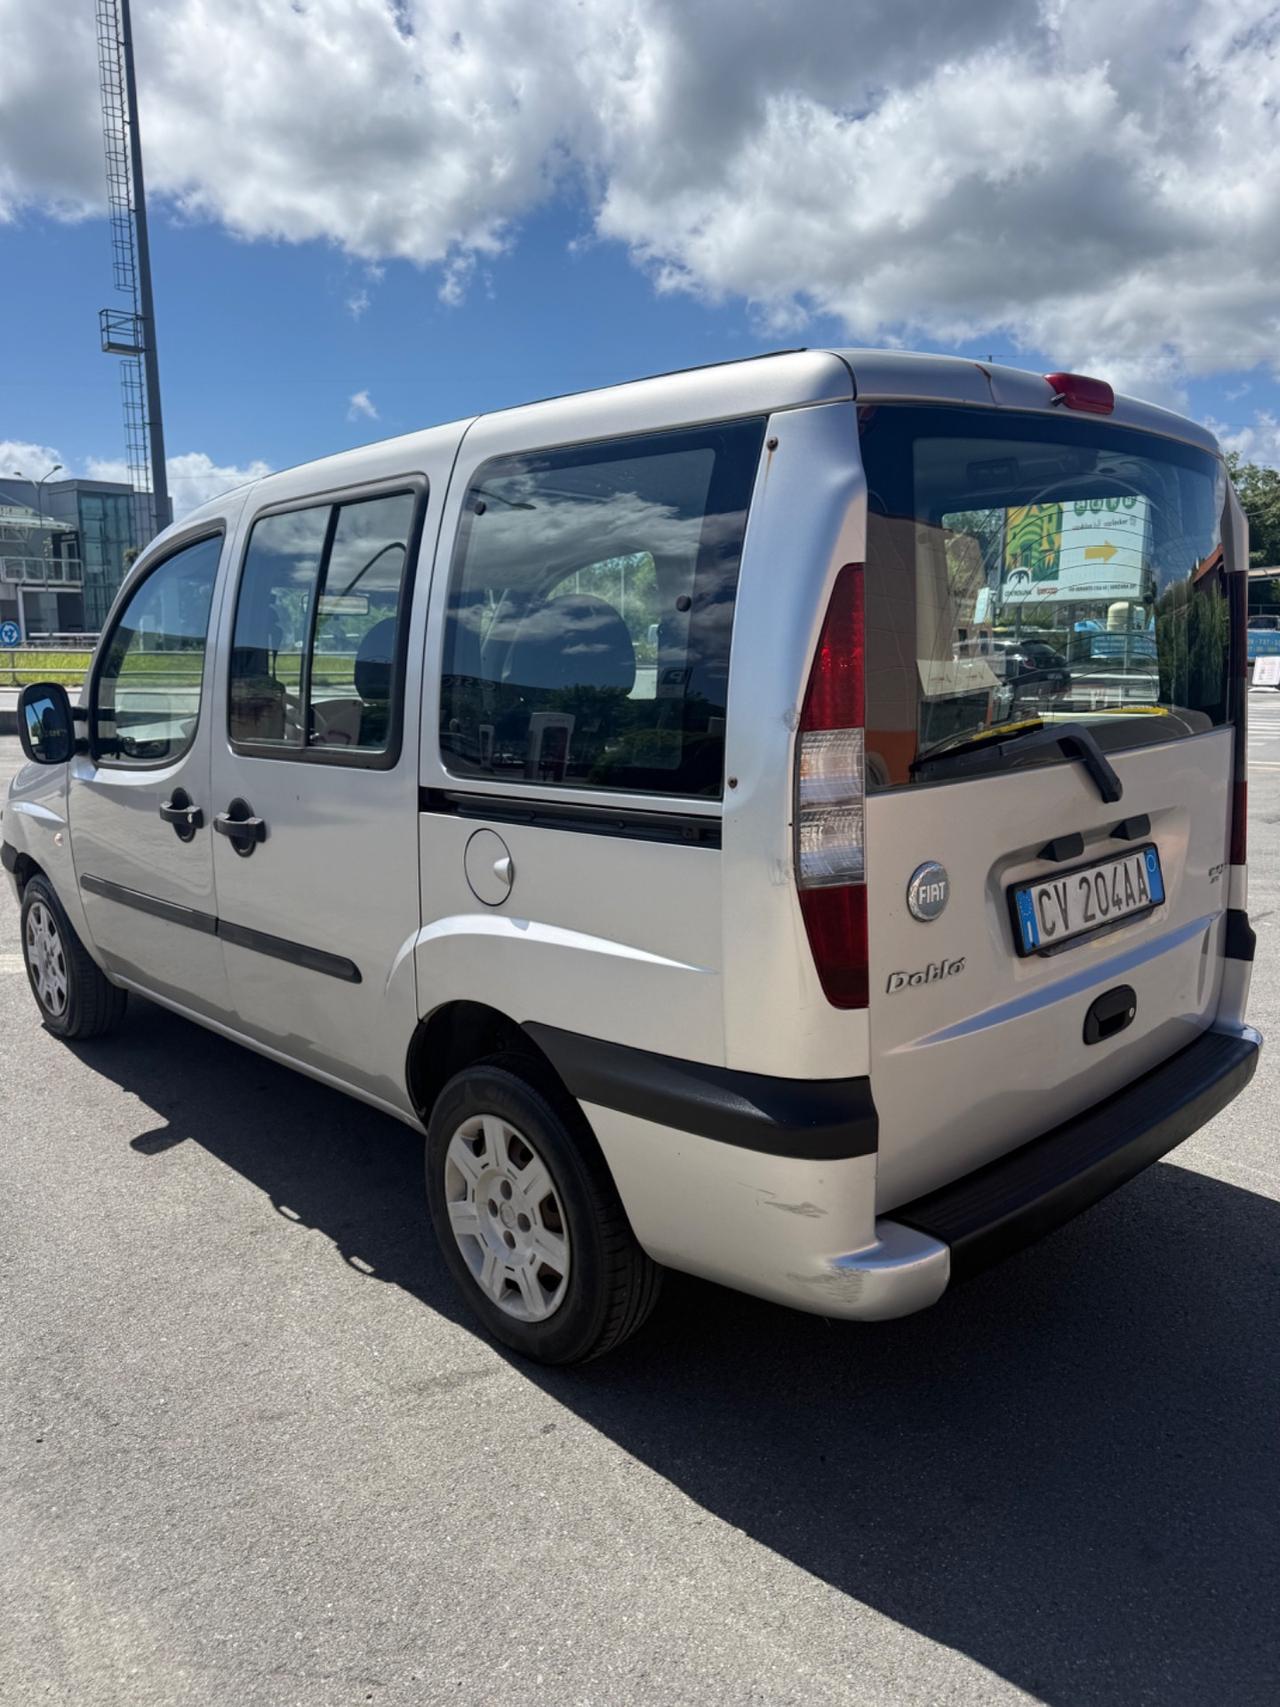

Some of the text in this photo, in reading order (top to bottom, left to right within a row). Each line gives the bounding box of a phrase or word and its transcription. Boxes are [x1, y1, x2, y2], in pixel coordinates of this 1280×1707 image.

[918, 881, 946, 905] FIAT
[1038, 881, 1069, 937] CV
[1078, 857, 1149, 923] 204AA
